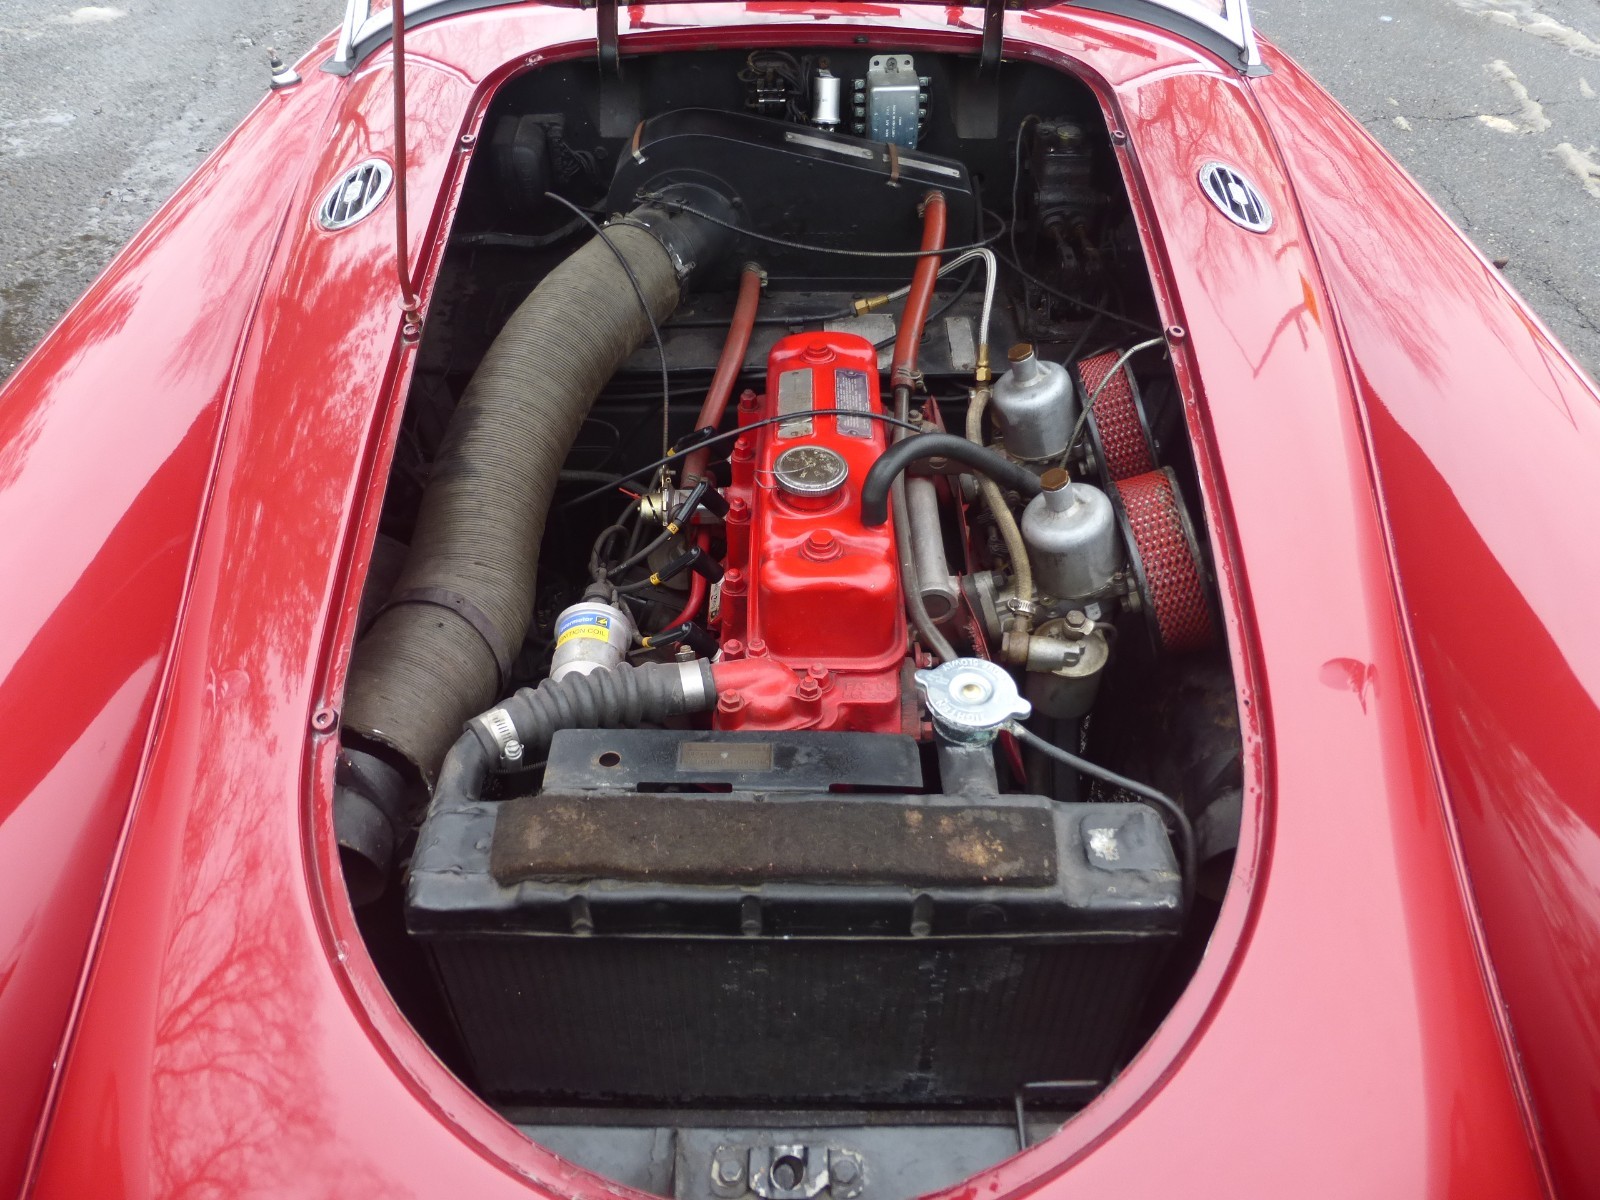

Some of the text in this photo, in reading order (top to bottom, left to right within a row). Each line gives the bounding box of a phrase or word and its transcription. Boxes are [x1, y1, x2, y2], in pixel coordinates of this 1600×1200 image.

[587, 628, 606, 636] COIL
[943, 659, 979, 671] SLOWLY
[936, 698, 984, 721] TIGHTEN
